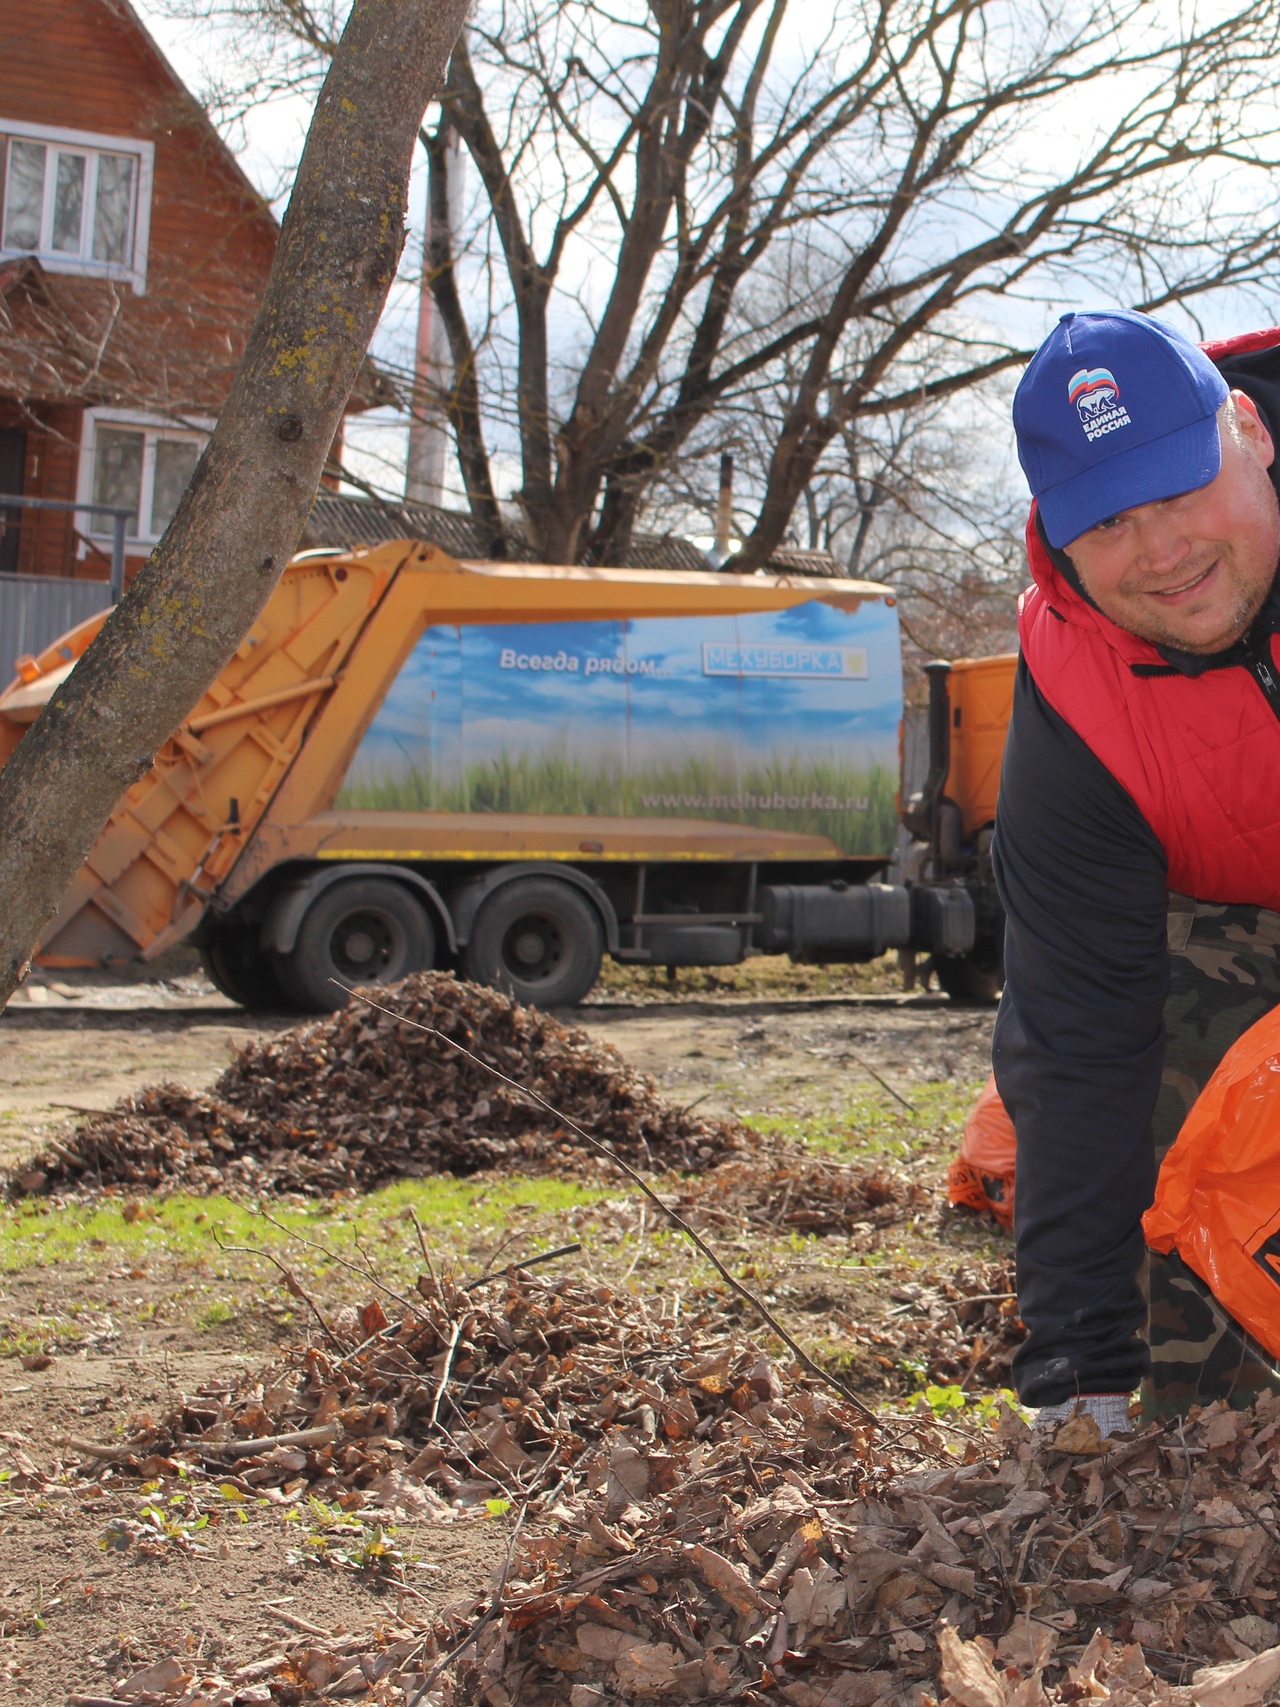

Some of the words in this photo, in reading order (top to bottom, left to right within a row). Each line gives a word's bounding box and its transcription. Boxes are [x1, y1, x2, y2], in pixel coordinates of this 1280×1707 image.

[1082, 406, 1127, 433] ЕДИНАЯ
[1086, 414, 1132, 442] РОССИЯ
[500, 648, 580, 671] Всегда
[708, 647, 842, 671] МЕХУБОРКА
[641, 791, 869, 810] www.mehuborka.ru
